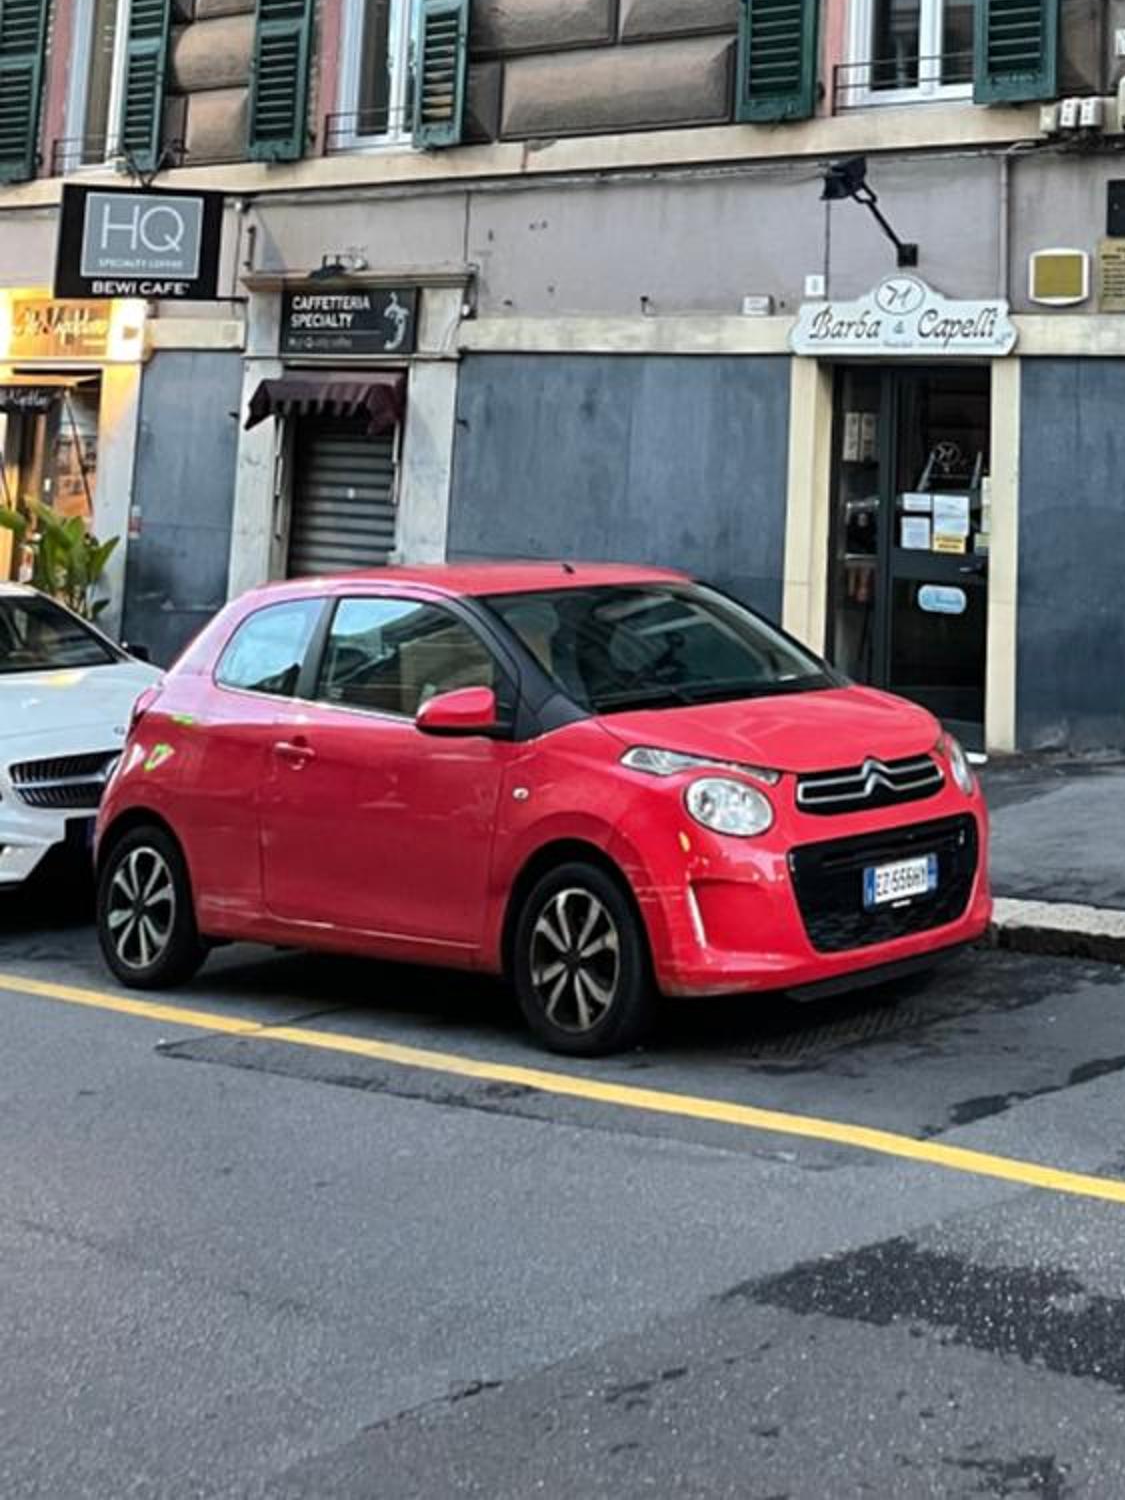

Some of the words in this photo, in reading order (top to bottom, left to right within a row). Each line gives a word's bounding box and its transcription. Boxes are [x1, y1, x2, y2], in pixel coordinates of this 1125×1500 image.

[101, 203, 184, 252] HQ
[91, 280, 137, 294] BEWI
[291, 295, 371, 311] CAFFETTERIA
[290, 312, 353, 329] SPECIALTY
[808, 305, 882, 339] Barba
[917, 307, 998, 348] Capelli
